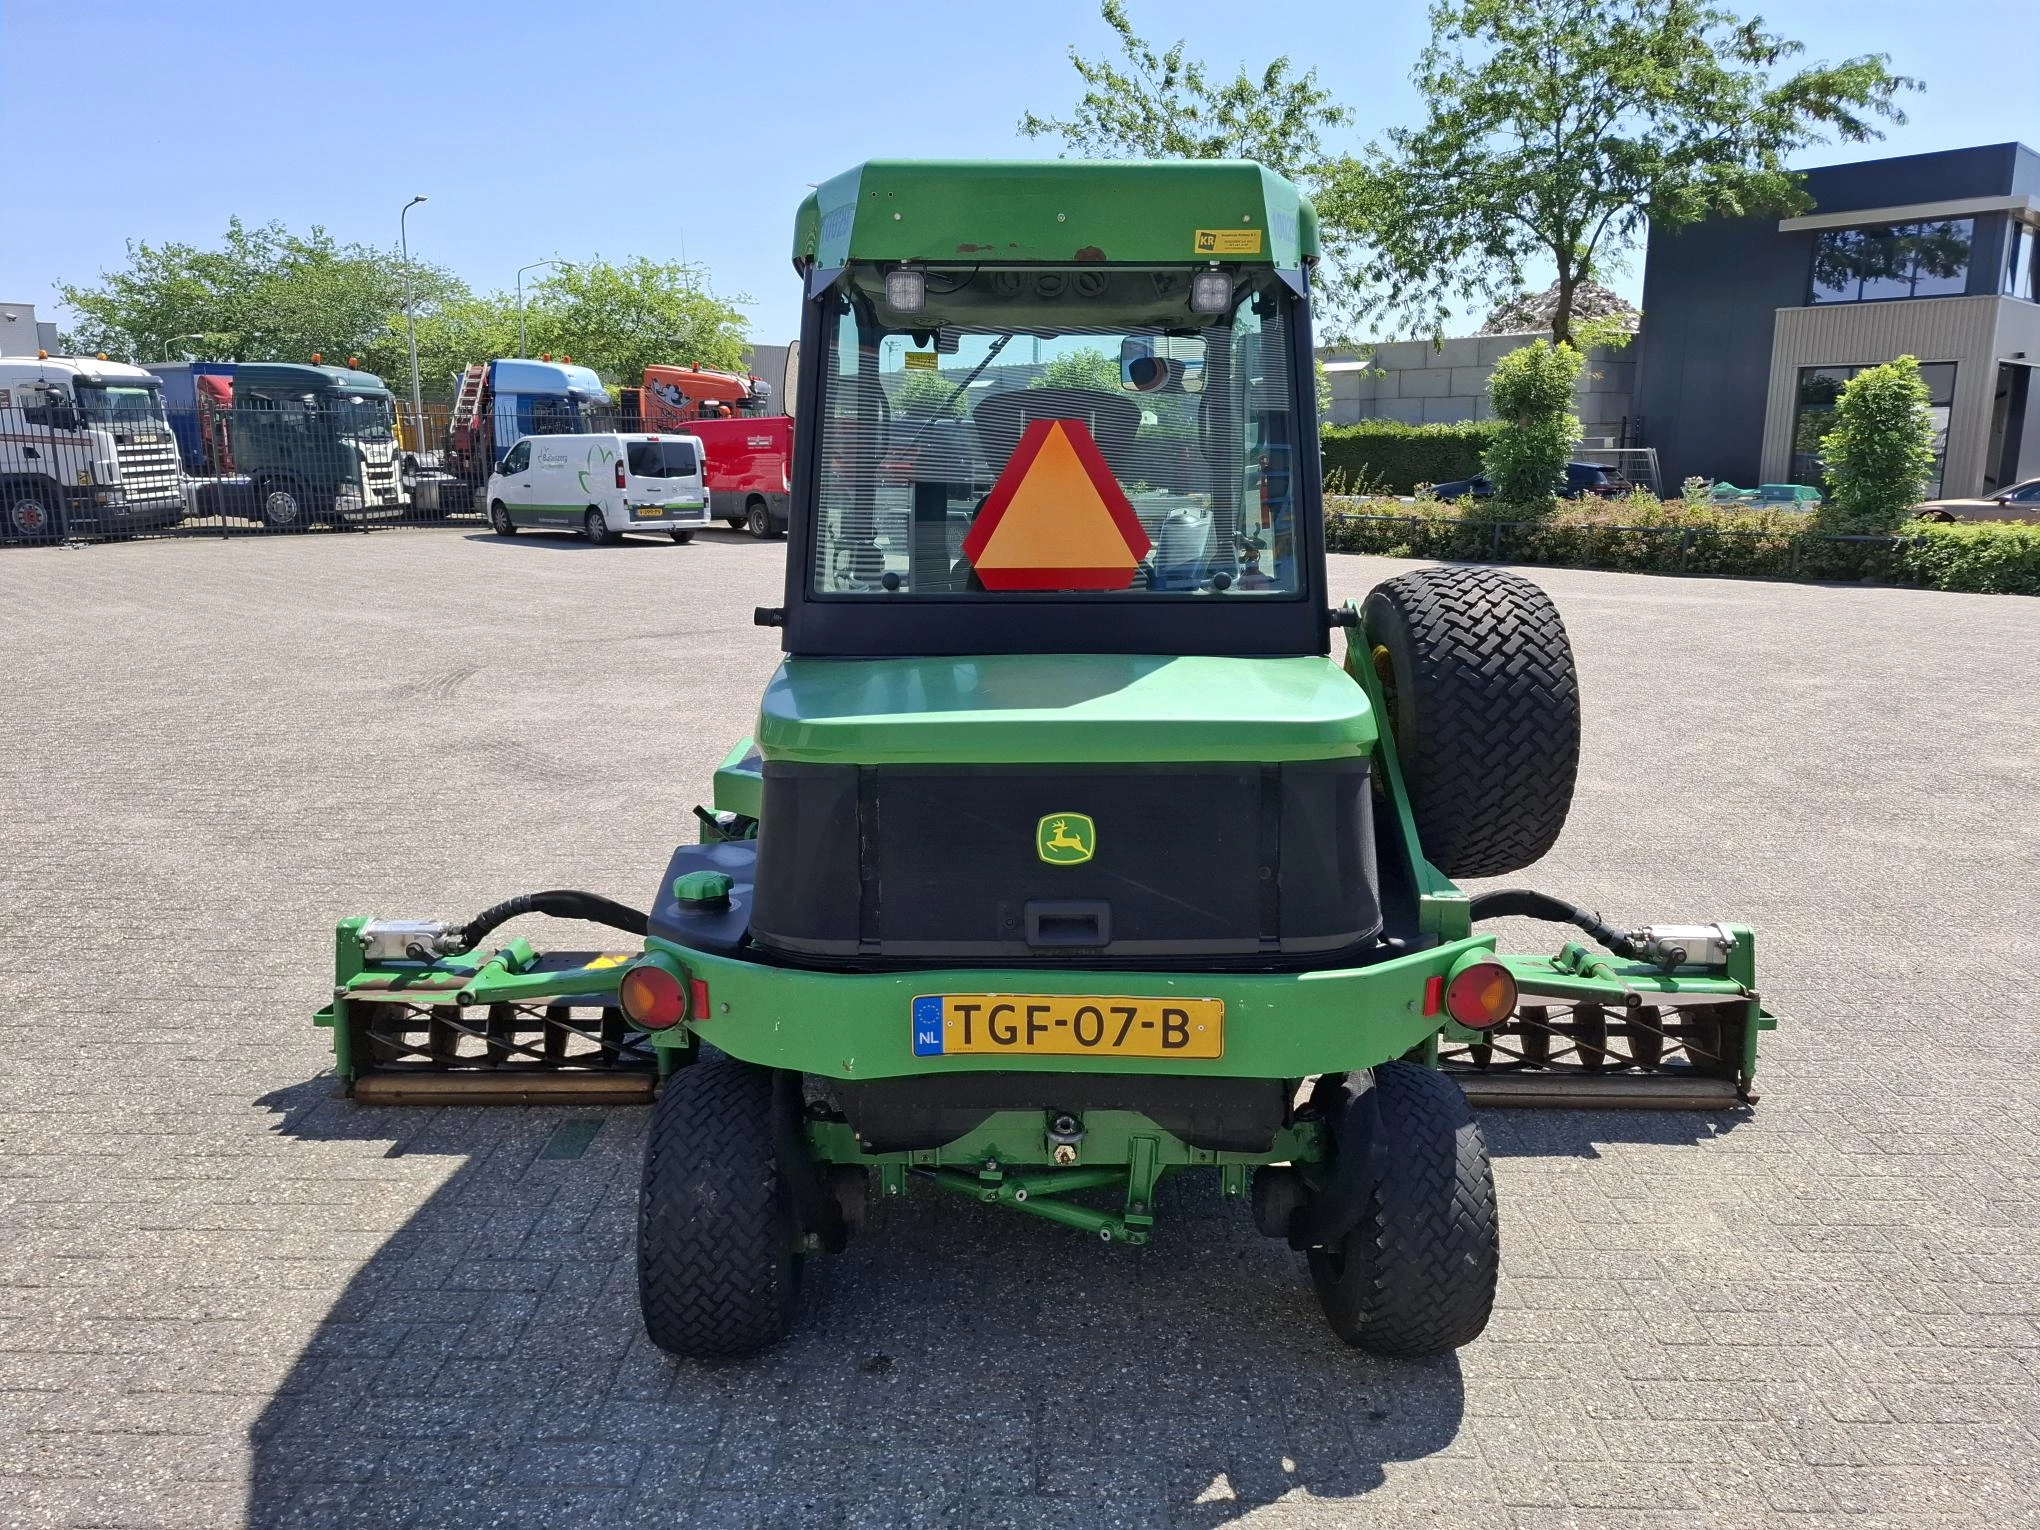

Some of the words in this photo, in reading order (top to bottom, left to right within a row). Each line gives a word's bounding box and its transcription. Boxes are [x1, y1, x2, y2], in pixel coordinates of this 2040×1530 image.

[1200, 236, 1214, 246] KR
[953, 1004, 1190, 1049] TGF-07-B
[919, 1032, 939, 1044] NL
